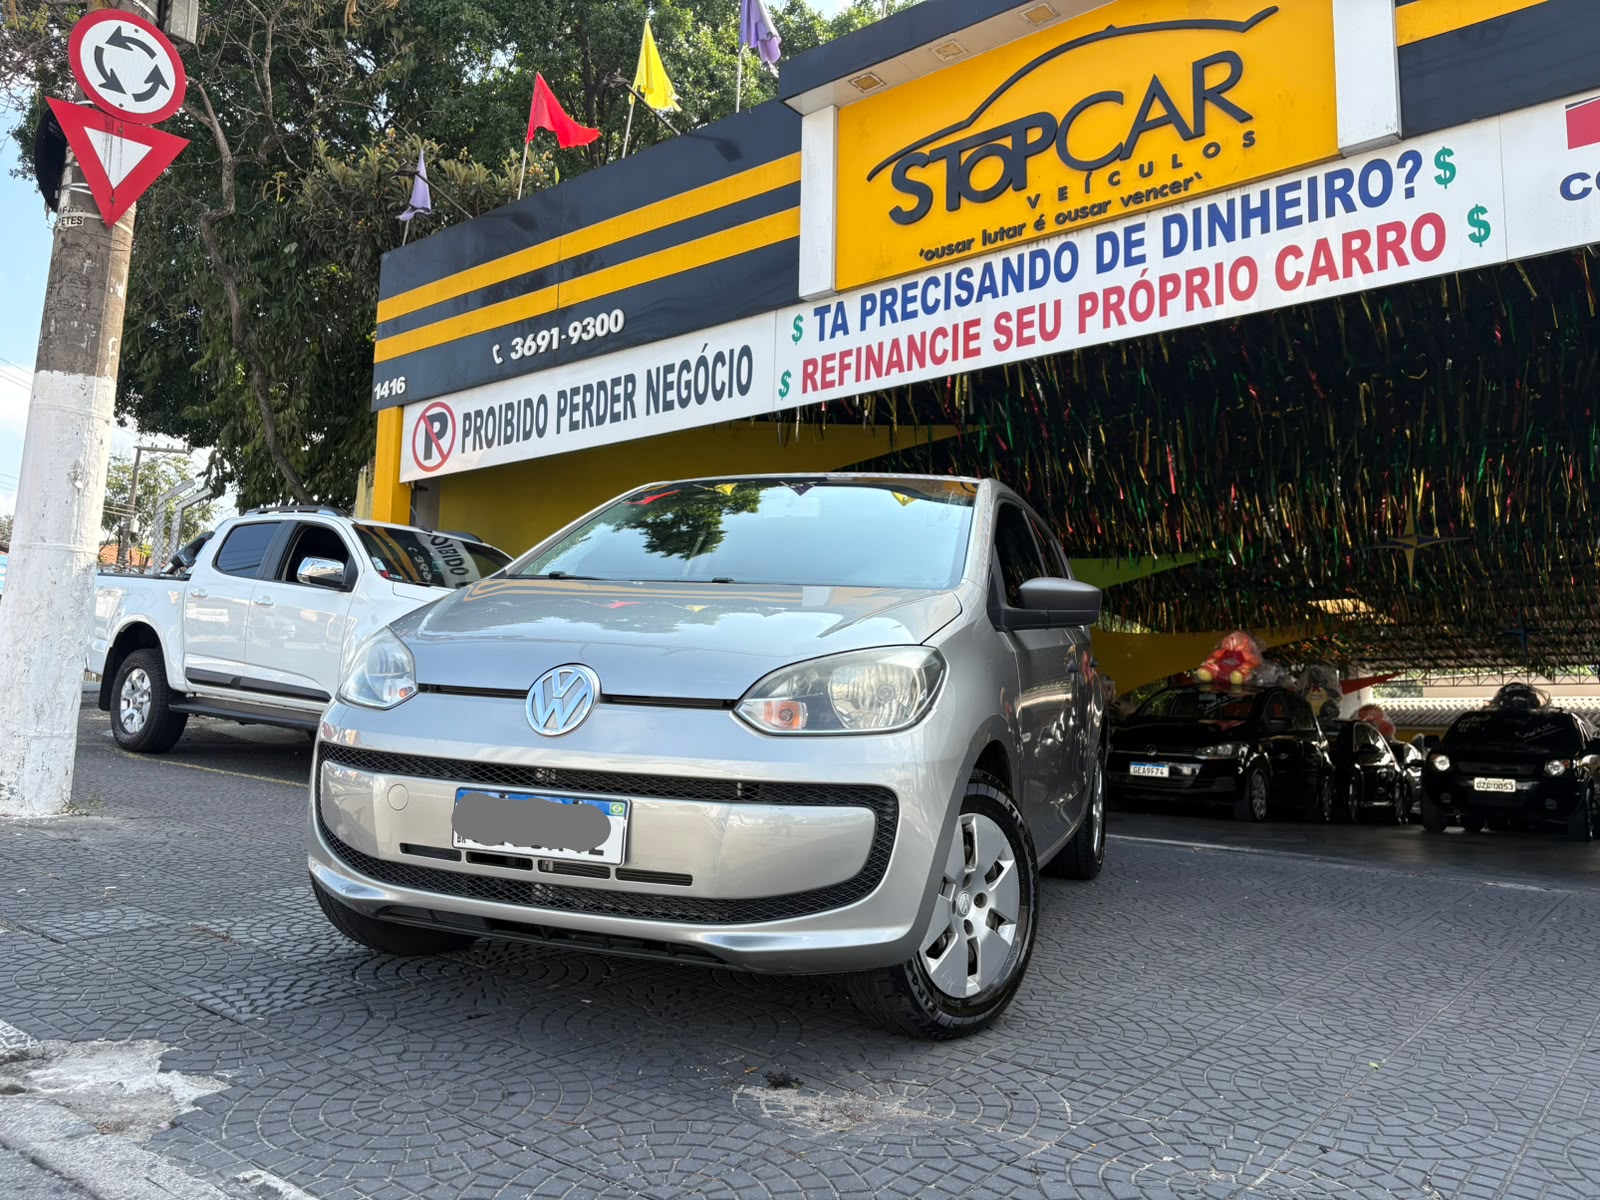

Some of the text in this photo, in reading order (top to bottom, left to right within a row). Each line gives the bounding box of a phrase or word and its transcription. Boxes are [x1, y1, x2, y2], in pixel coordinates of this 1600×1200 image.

[888, 50, 1253, 225] STOPCAR
[1027, 130, 1256, 209] VEÍCULOS
[981, 224, 1026, 247] lutar
[1034, 214, 1046, 233] é
[1055, 201, 1112, 226] ousar
[1560, 172, 1600, 201] C
[791, 146, 1456, 346] $ TA PRECISANDO DE DINHEIRO? $
[511, 309, 625, 360] 3691-9300
[778, 204, 1491, 401] $ REFINANCIE SEU PRÓPRIO CARRO $
[374, 376, 406, 400] 1416
[462, 394, 548, 453] PROIBIDO
[557, 374, 637, 434] PERDER
[646, 343, 753, 417] NEGÓCIO
